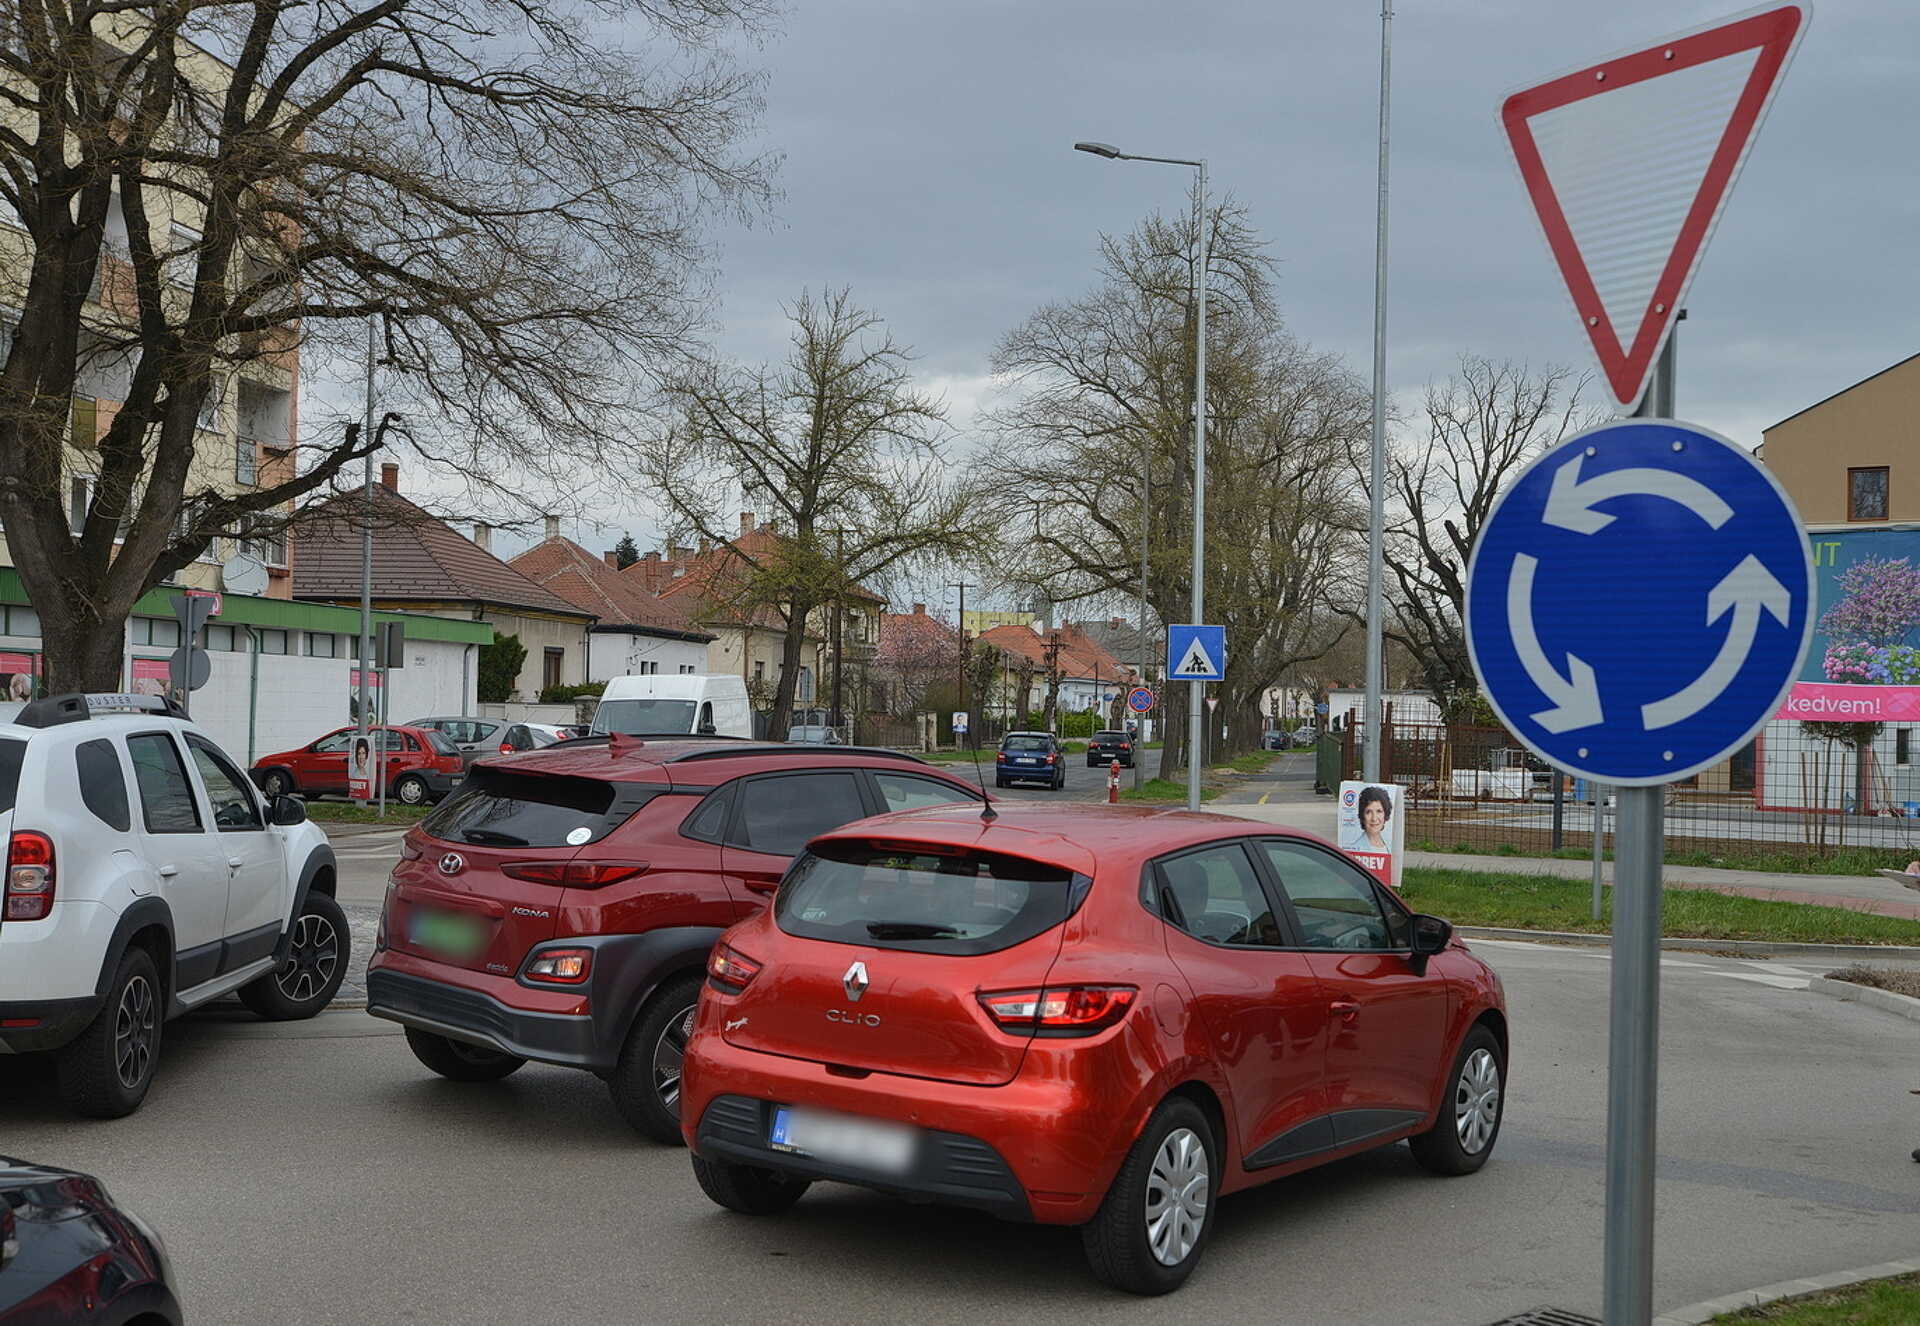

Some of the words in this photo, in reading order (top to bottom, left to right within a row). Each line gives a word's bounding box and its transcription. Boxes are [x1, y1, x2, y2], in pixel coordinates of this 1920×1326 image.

[87, 696, 132, 706] DUSTER
[1787, 695, 1881, 714] kedvem!
[512, 906, 549, 918] KONA
[826, 1009, 881, 1027] CLIO
